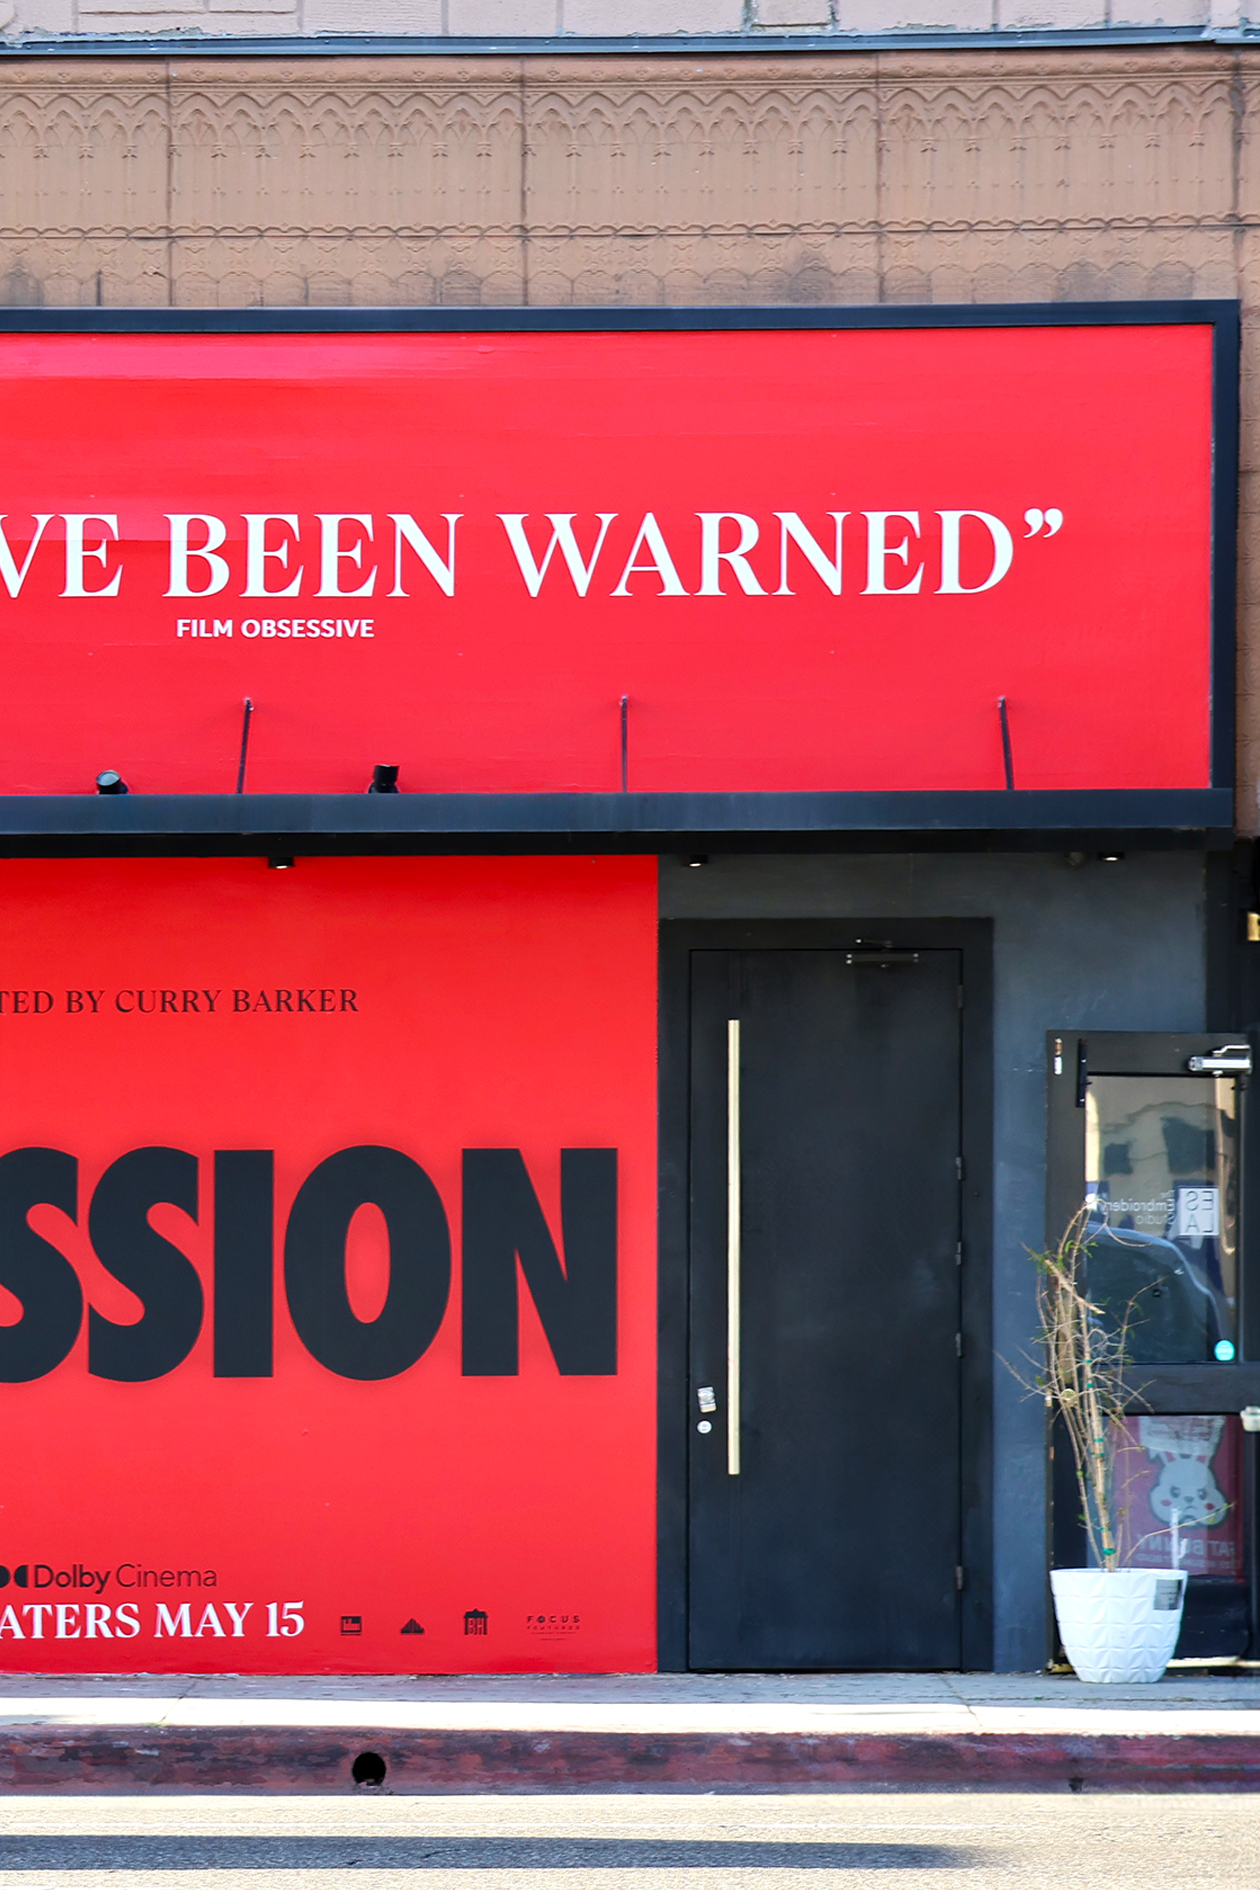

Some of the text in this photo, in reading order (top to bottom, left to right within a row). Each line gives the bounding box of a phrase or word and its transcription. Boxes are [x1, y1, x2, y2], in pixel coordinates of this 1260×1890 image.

[162, 513, 464, 598] BEEN
[495, 508, 1064, 598] WARNED”
[177, 619, 375, 638] FILM OBSESSIVE
[66, 990, 105, 1014] BY
[115, 989, 222, 1014] CURRY
[233, 989, 358, 1013] BARKER
[33, 1563, 112, 1595] Dolby
[115, 1563, 218, 1588] Cinema
[154, 1602, 254, 1639] MAY
[266, 1600, 305, 1638] 15
[526, 1615, 581, 1624] FOCUS
